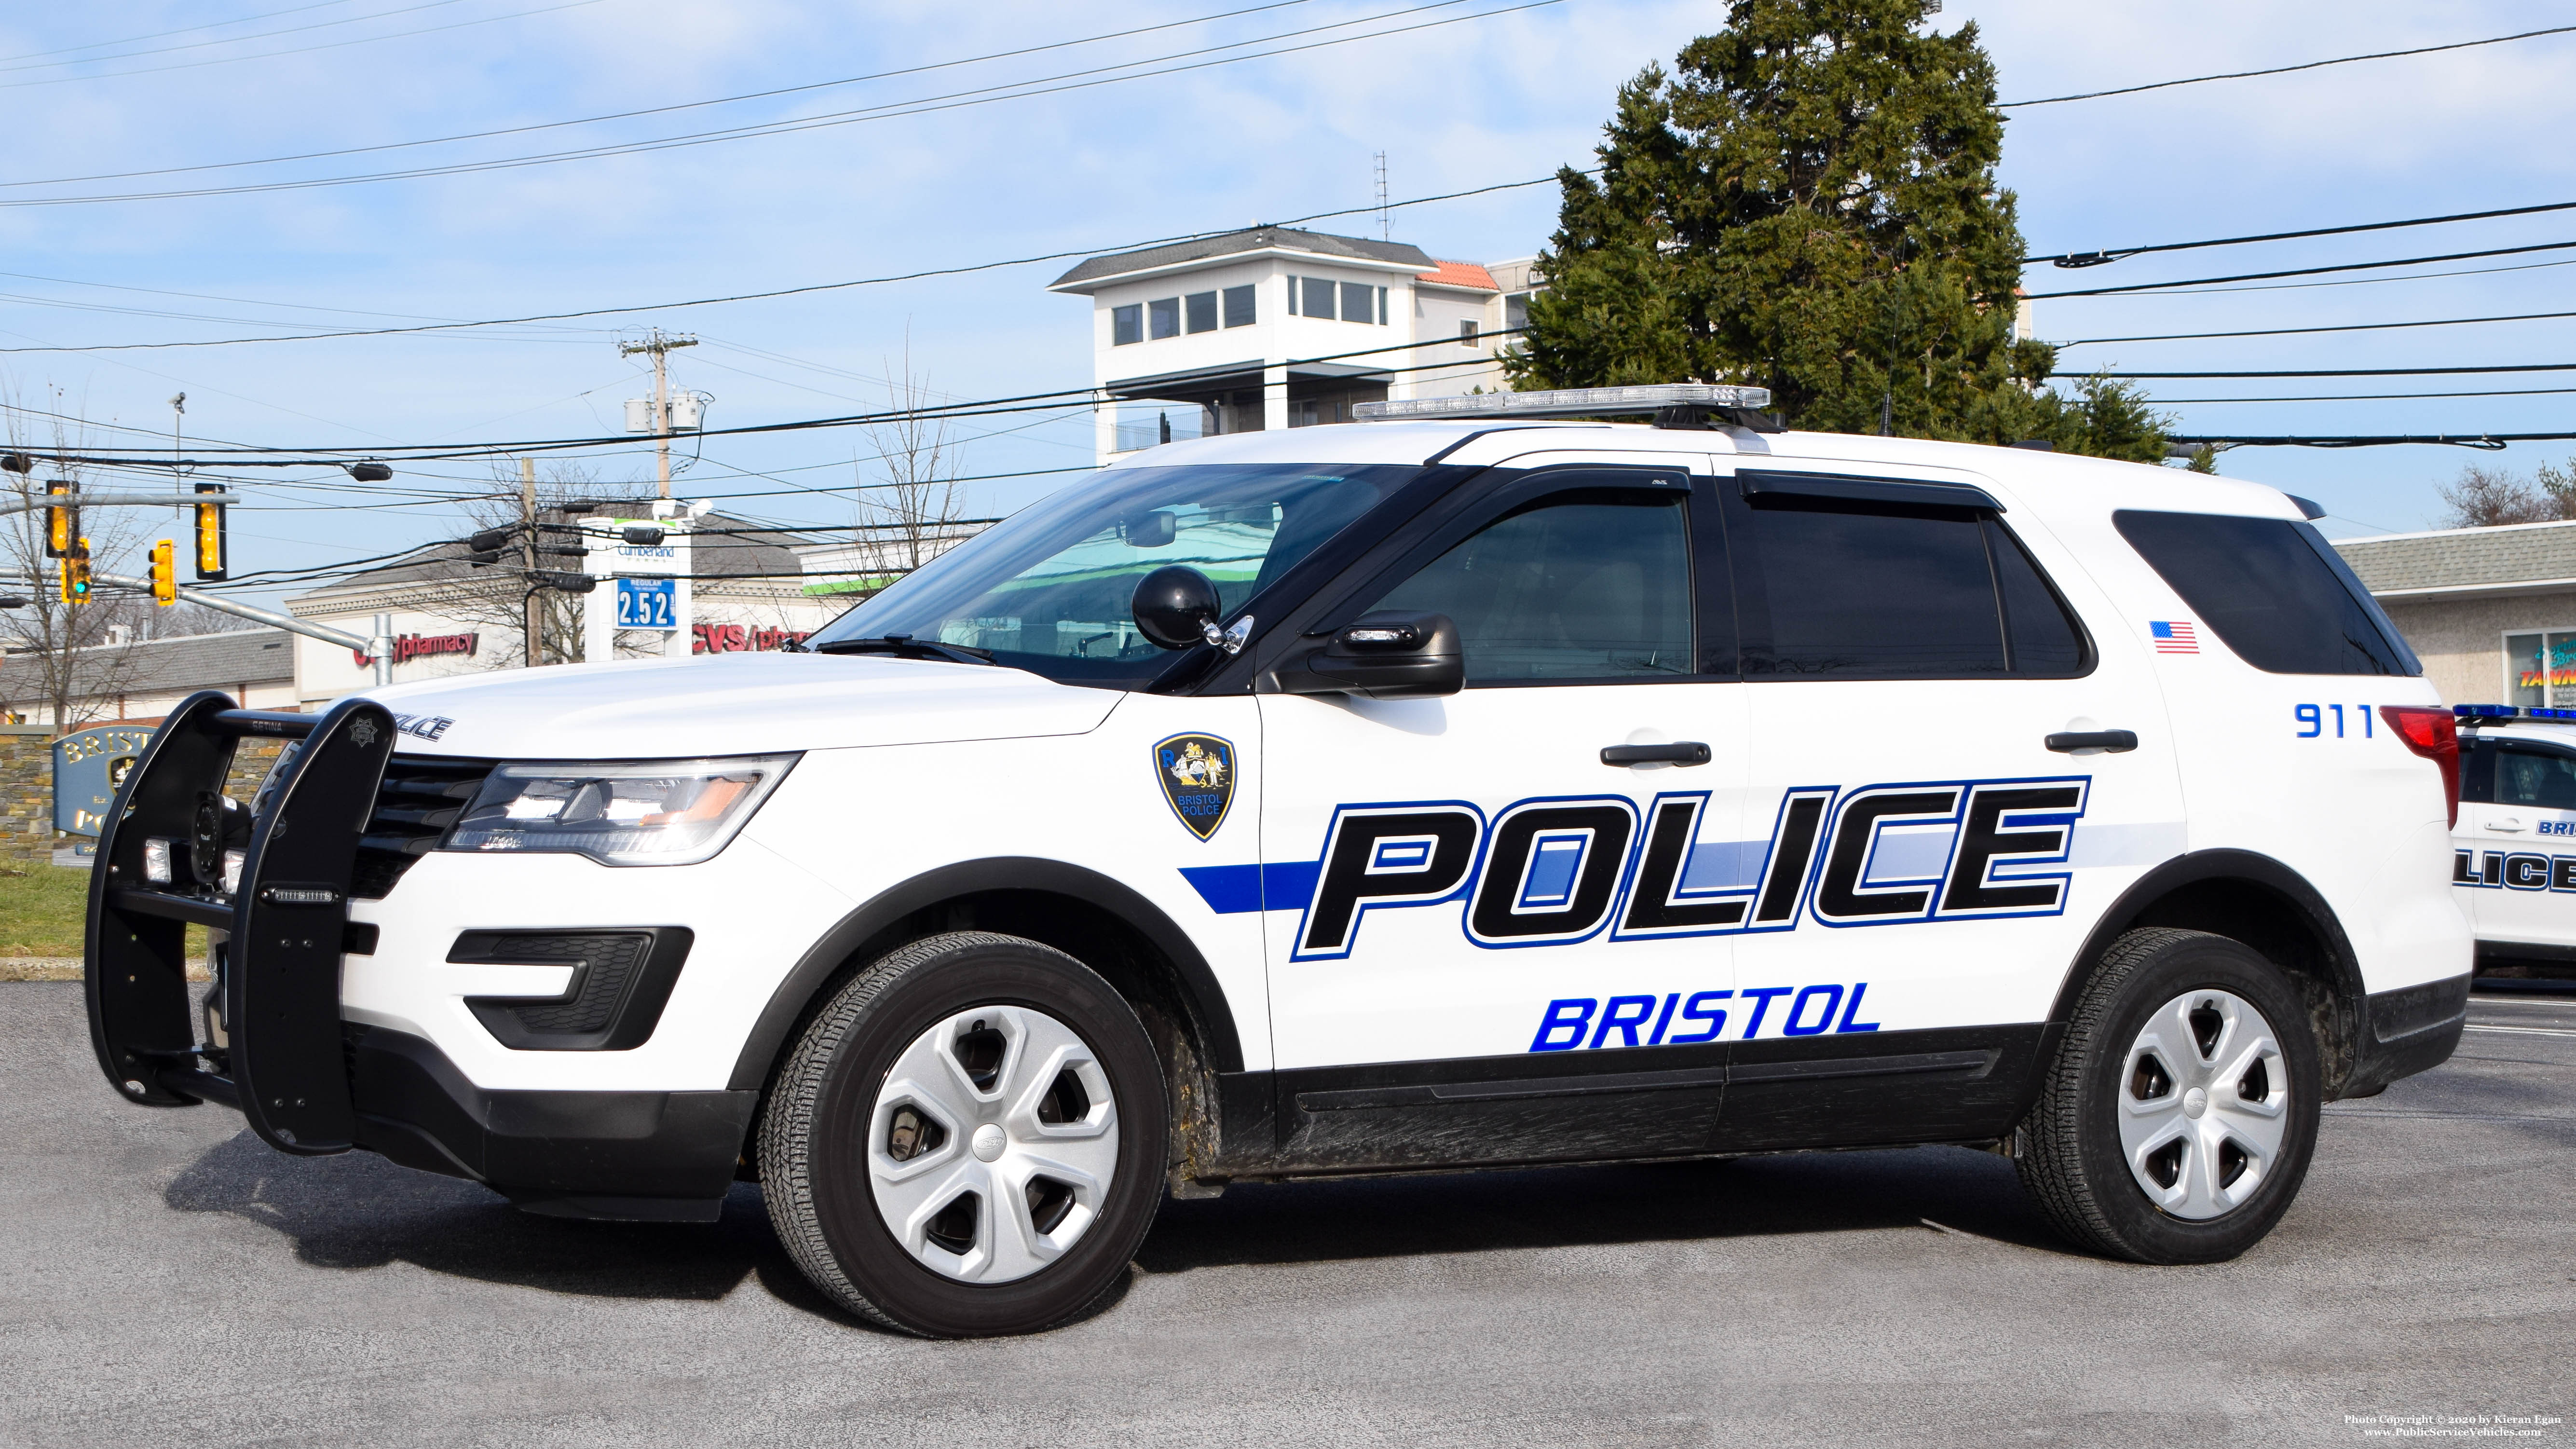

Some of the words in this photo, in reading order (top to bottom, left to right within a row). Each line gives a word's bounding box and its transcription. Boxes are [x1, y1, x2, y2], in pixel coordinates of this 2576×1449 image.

[618, 543, 674, 557] Cumberland
[619, 592, 668, 624] 2.52
[253, 721, 282, 731] SETINA
[392, 712, 456, 743] OLICE
[2294, 704, 2372, 738] 911
[63, 732, 154, 764] BRIST
[1161, 750, 1177, 767] R
[1220, 747, 1228, 765] I
[1178, 794, 1223, 805] BRISTOL
[1183, 805, 1220, 816] POLICE
[2536, 820, 2576, 837] BRI
[1289, 775, 2092, 963] POLICE
[1528, 983, 1881, 1053] BRISTOL
